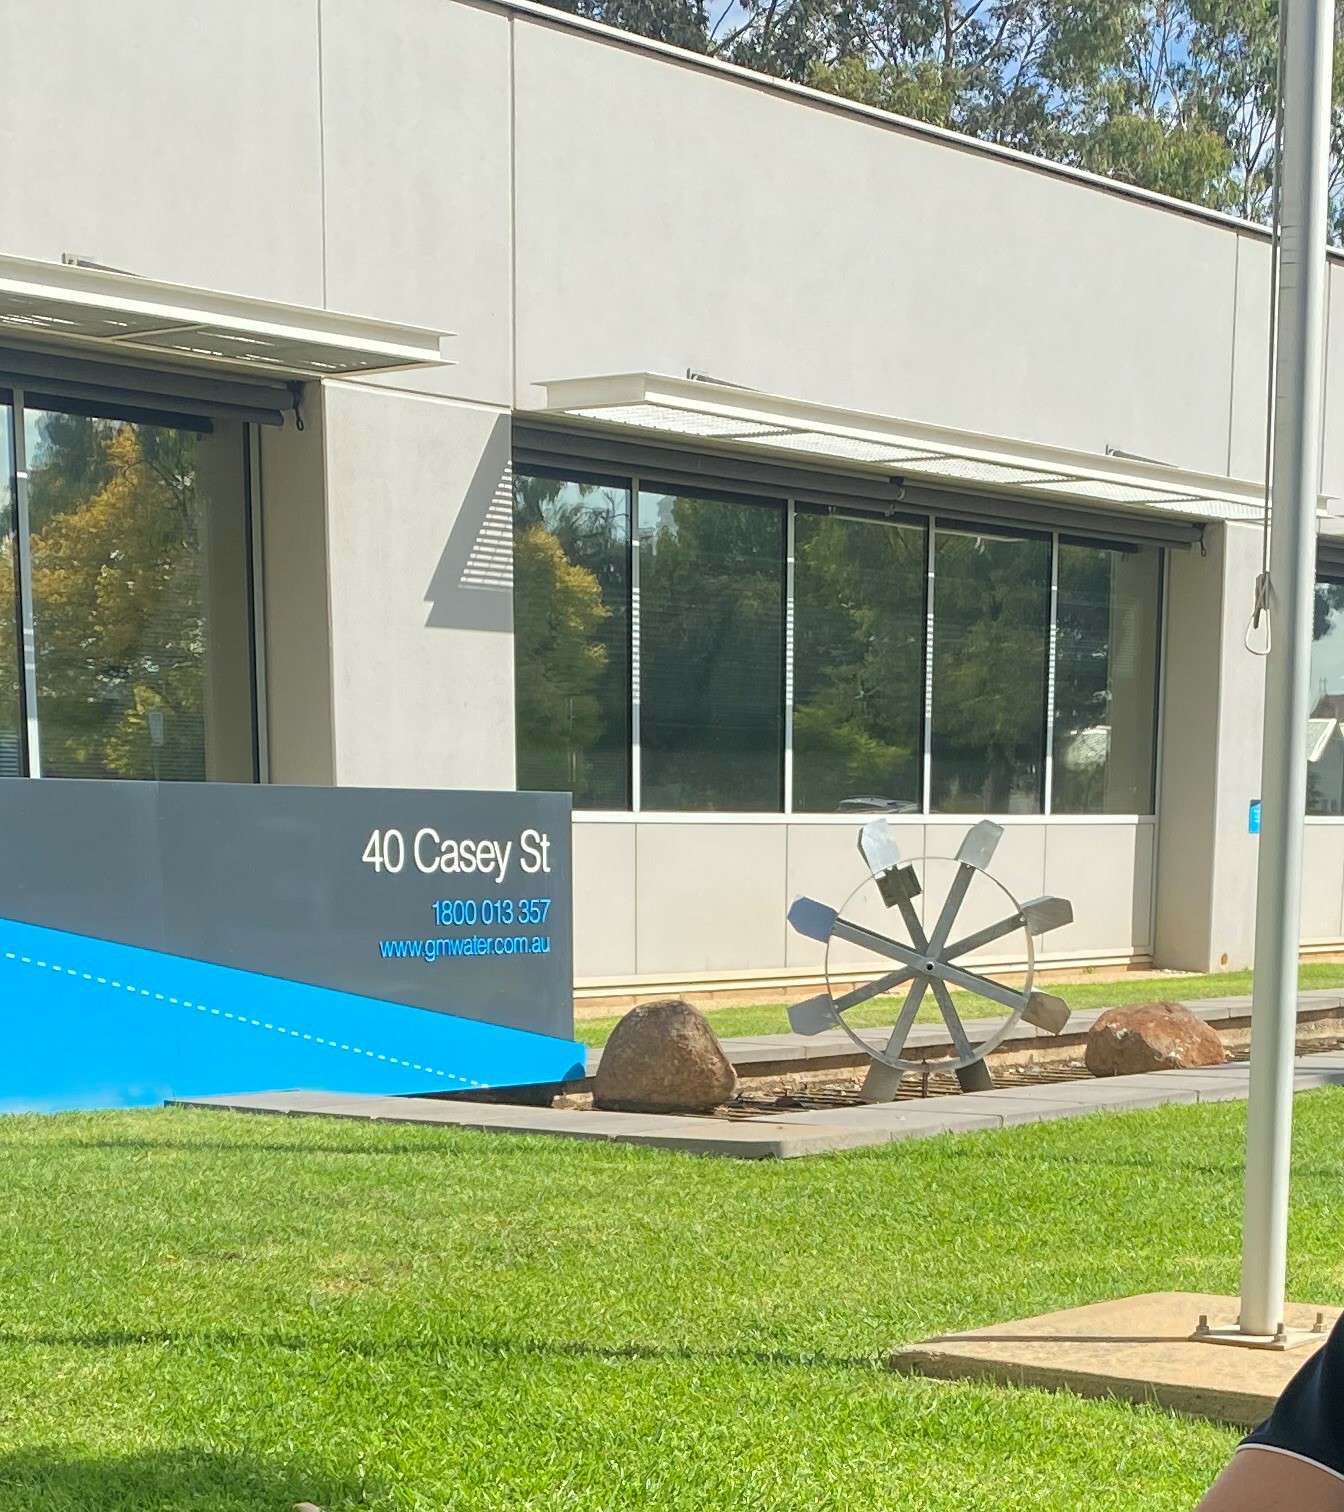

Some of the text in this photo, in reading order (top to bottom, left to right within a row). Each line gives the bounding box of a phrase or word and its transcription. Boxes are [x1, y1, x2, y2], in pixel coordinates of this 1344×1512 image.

[361, 827, 551, 884] 40 Casey St
[432, 899, 552, 925] 1800 013 357
[379, 935, 551, 963] www.gmwater.com.au
